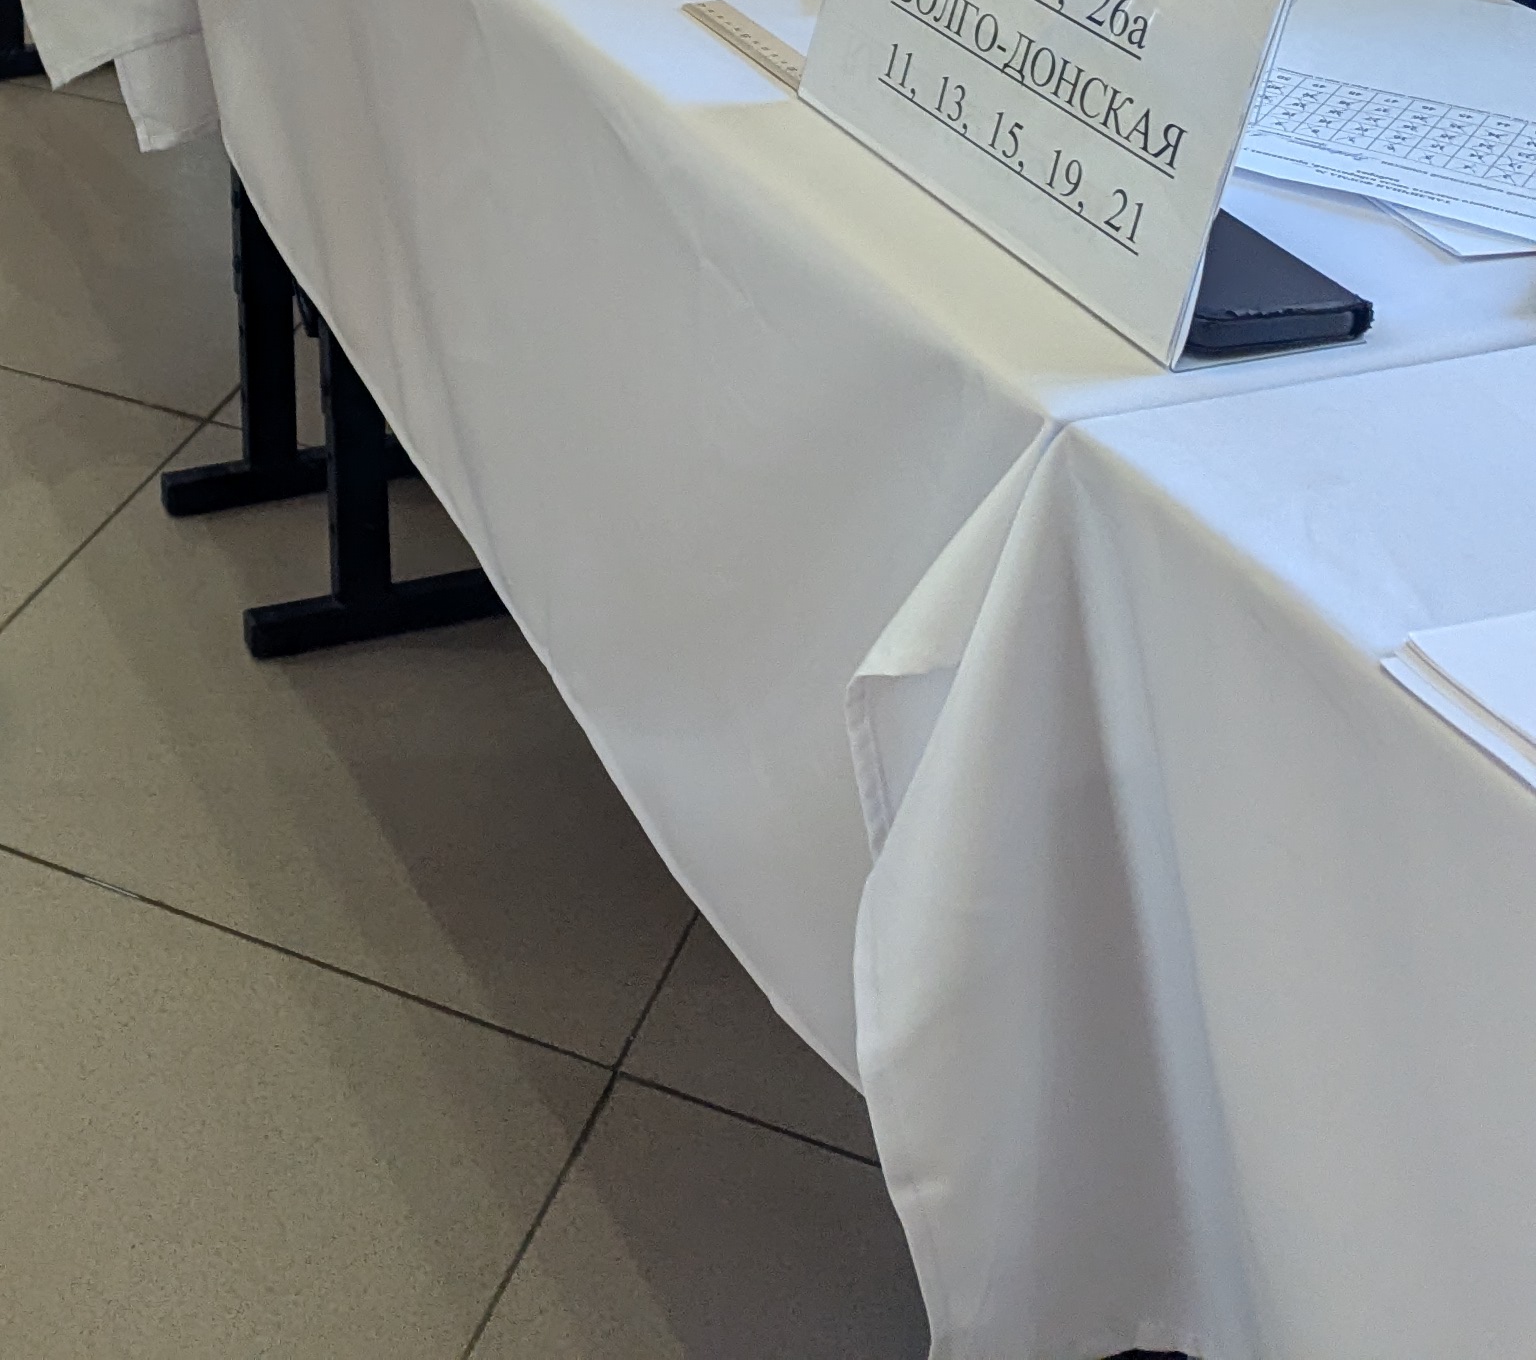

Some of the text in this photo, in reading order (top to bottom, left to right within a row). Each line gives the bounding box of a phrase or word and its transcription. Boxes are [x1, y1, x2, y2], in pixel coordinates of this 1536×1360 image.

[883, 43, 1145, 245] 11, 13, 15, 19, 21
